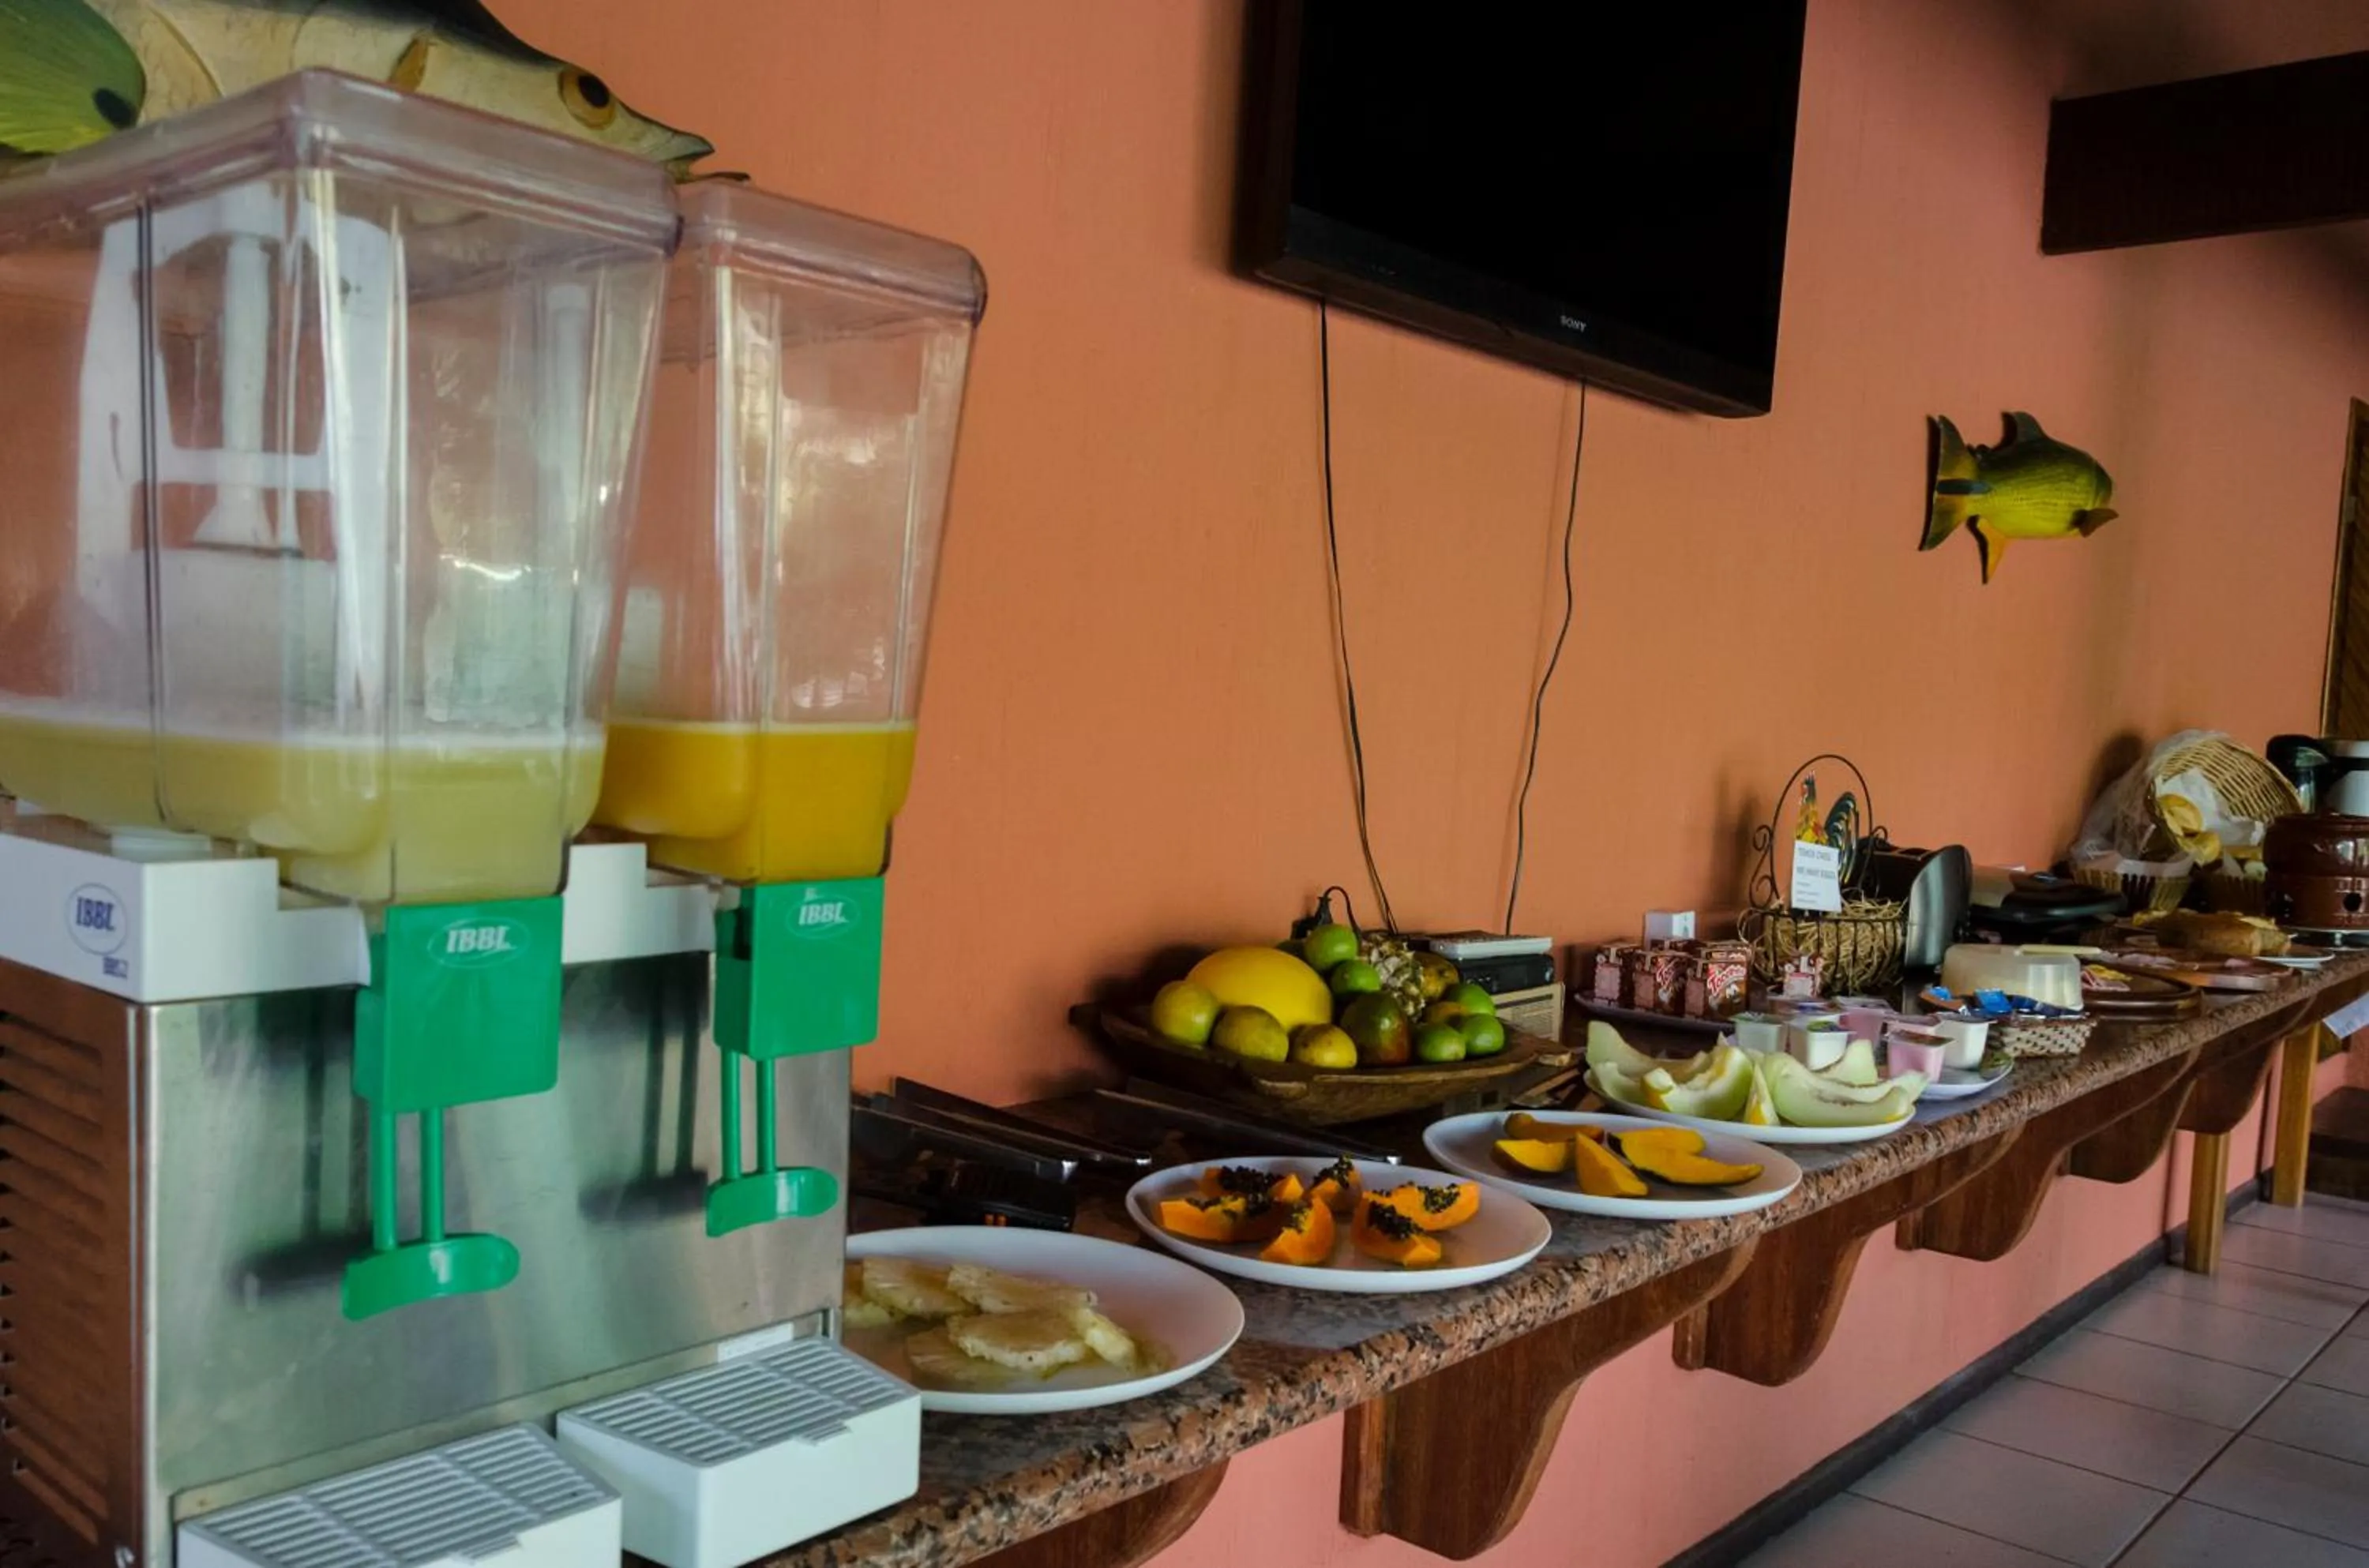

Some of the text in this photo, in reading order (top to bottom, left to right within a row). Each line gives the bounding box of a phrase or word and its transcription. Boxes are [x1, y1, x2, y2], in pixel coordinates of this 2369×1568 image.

[1560, 315, 1587, 332] SONY
[76, 896, 115, 932] IBBL
[798, 902, 849, 925] IBBL
[446, 925, 516, 954] IBBL
